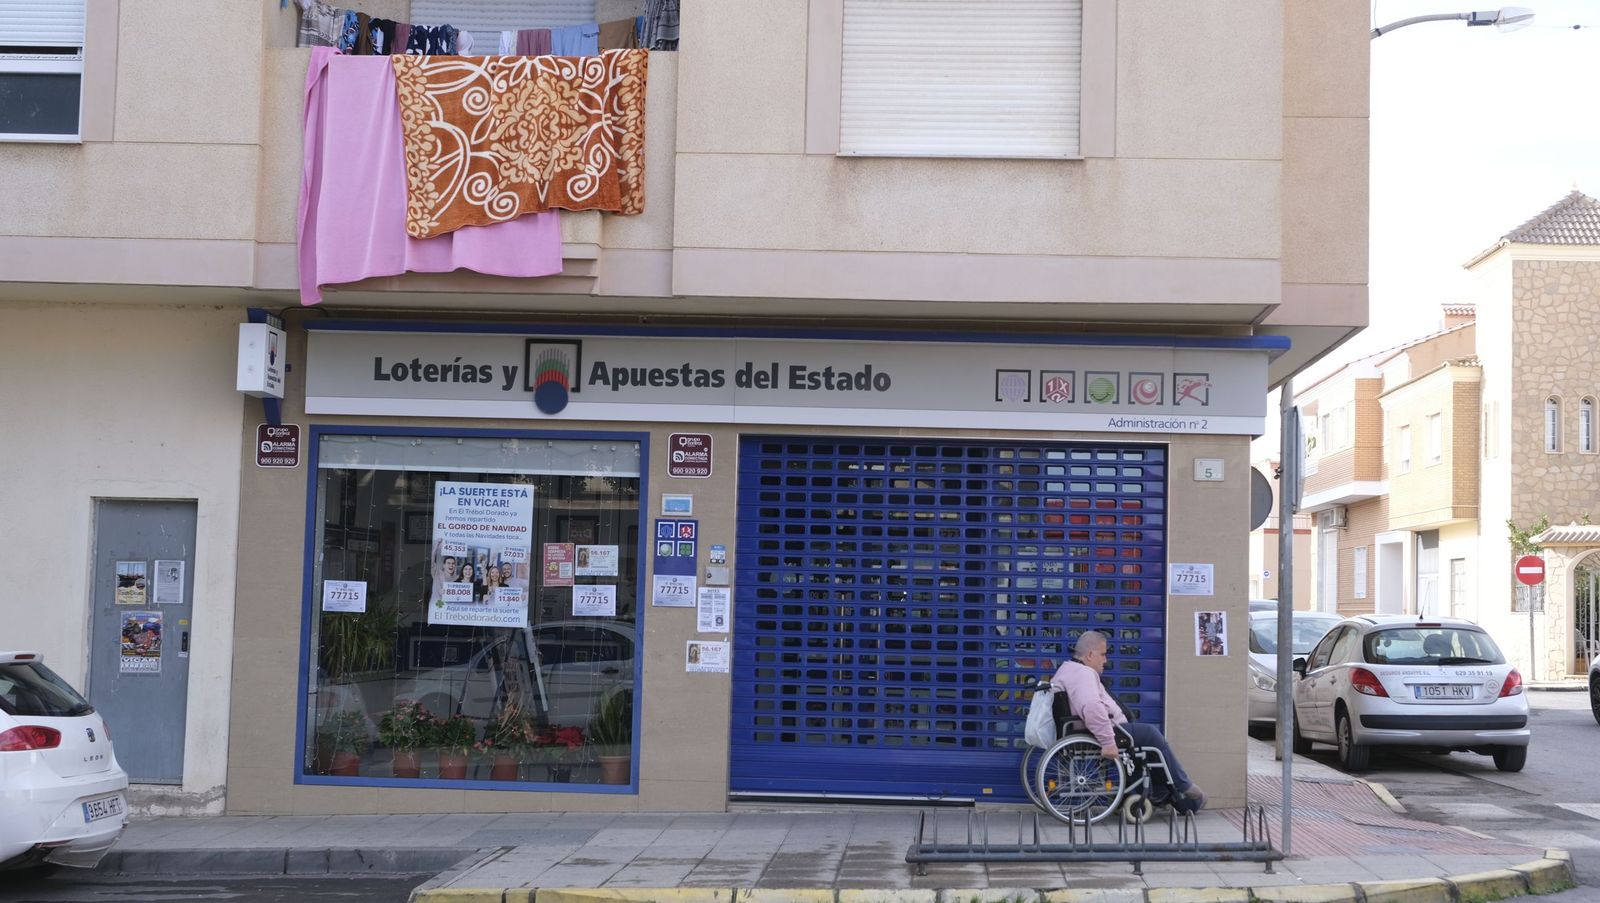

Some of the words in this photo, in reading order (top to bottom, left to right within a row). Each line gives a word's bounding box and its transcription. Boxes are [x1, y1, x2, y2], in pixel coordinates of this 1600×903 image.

[374, 356, 493, 384] Loterías
[502, 365, 519, 391] y
[588, 360, 726, 392] Apuestas
[735, 362, 779, 389] del
[788, 364, 892, 392] Estado
[1108, 417, 1186, 429] Administración
[1201, 419, 1208, 430] 2
[1205, 468, 1213, 479] 5
[440, 486, 456, 496] ¡LA
[458, 487, 498, 496] SUERTE
[501, 487, 528, 498] ESTÁ
[458, 498, 471, 506] EN
[474, 497, 510, 508] VÍCAR!
[1176, 574, 1207, 583] 77715
[330, 591, 359, 600] 77715
[660, 586, 689, 595] 77715
[580, 596, 609, 604] 77715
[445, 612, 520, 623] Treboldorado.com
[1424, 687, 1446, 696] 1051
[1452, 687, 1470, 696] HKV
[88, 800, 108, 818] 9654
